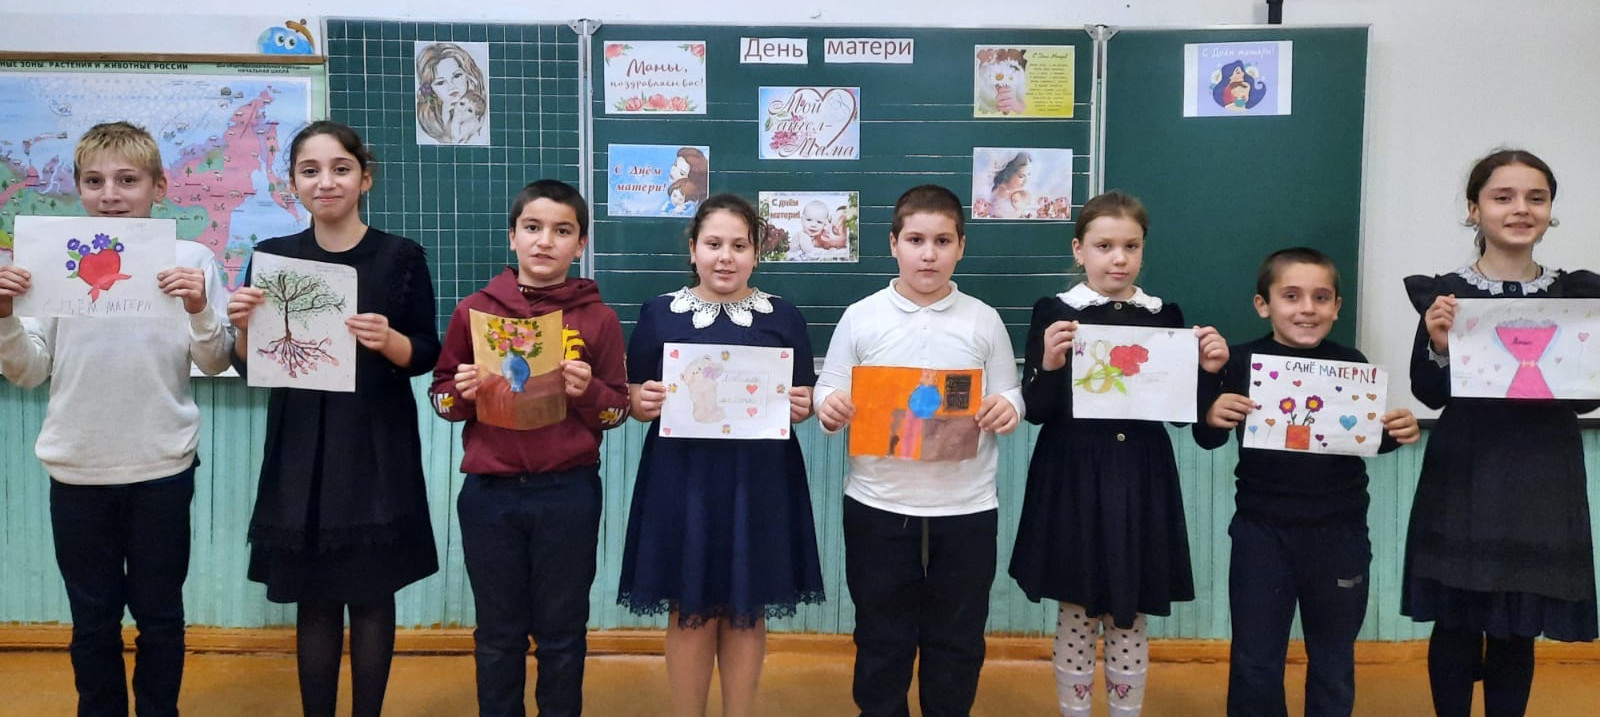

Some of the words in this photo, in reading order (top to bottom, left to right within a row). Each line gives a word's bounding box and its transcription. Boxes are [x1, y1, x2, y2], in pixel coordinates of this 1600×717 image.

[744, 38, 803, 61] День
[827, 40, 911, 60] матери
[50, 61, 92, 70] РАСТЕНИЯ
[95, 62, 101, 70] И
[104, 62, 152, 71] ЖИВОТНЫЕ
[154, 62, 188, 71] РОССИИ
[626, 58, 688, 77] Мамы,
[610, 78, 680, 90] поздравляем
[682, 77, 704, 88] вас!
[768, 90, 822, 116] Мой
[778, 137, 854, 158] Мама
[614, 164, 624, 175] С
[617, 183, 666, 195] матери!
